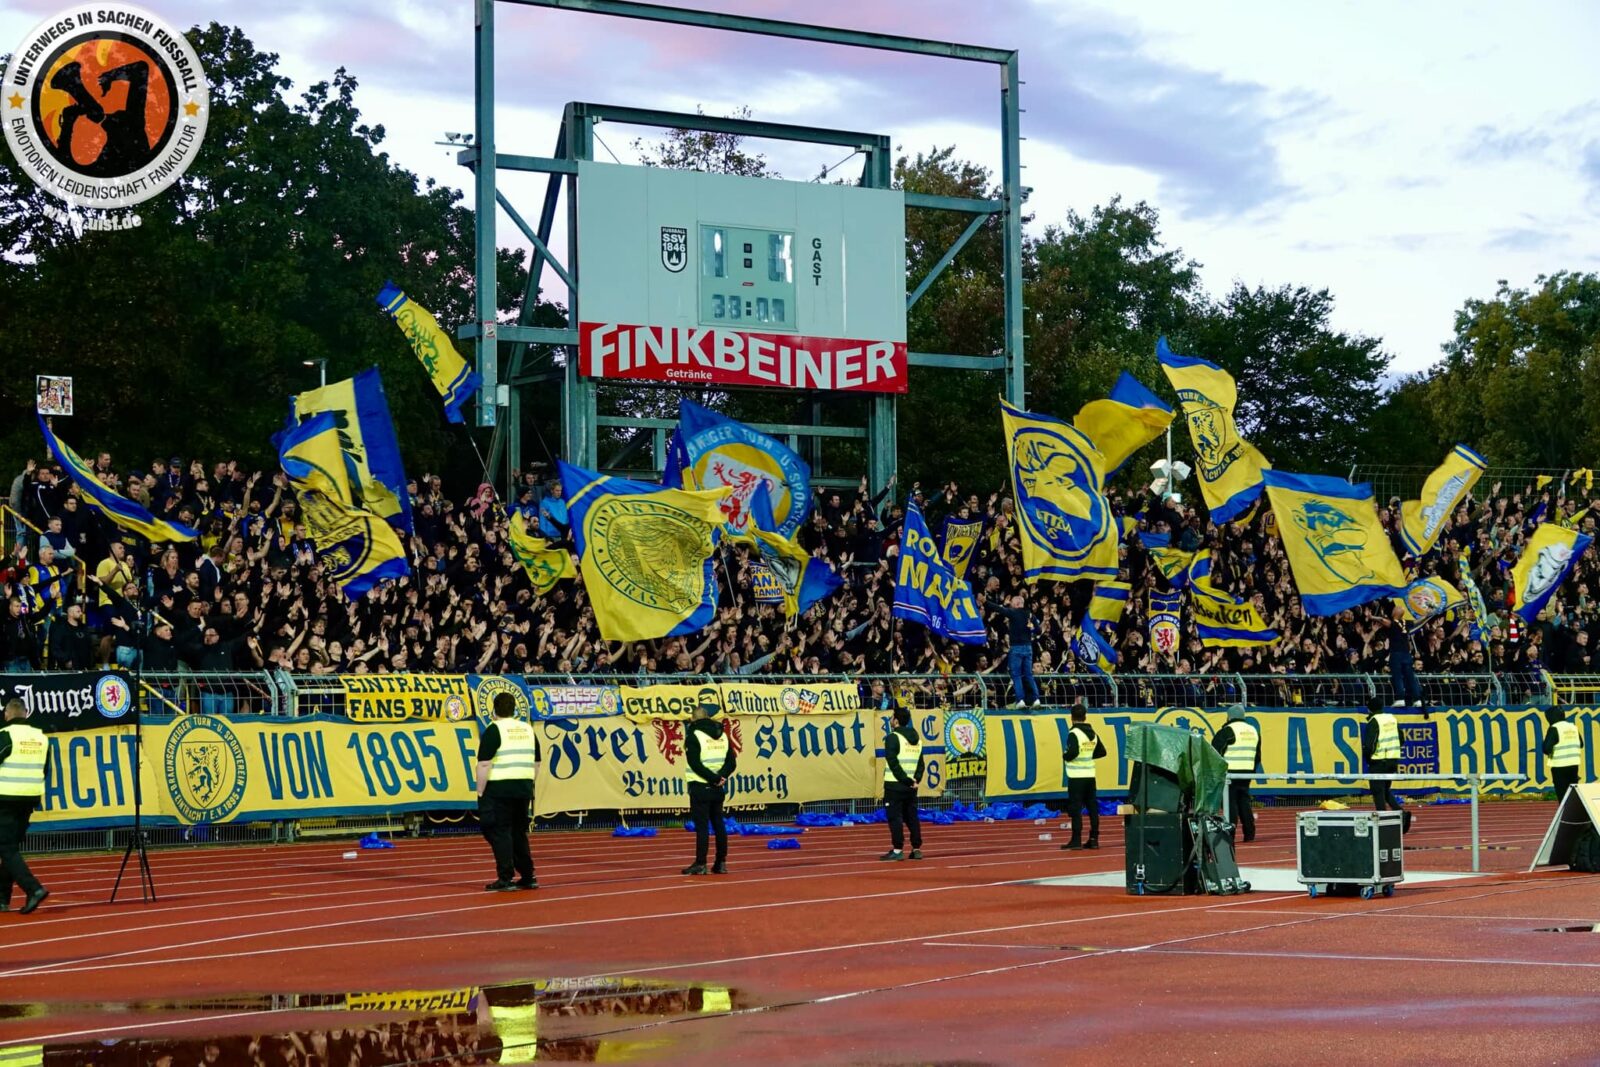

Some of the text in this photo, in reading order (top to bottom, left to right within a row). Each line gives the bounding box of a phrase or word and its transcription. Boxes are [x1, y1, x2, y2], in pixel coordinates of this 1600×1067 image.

[662, 233, 686, 243] SSV
[662, 243, 686, 252] 1846
[812, 238, 822, 286] GAST
[590, 323, 898, 390] FINKBEINER
[666, 368, 713, 380] Getränke
[343, 677, 465, 694] EINTRACHT
[14, 684, 95, 719] Jungs
[350, 698, 443, 719] FANS BW
[626, 696, 697, 715] CHAOS
[166, 720, 192, 792] BRAUNSCHWEIGER
[193, 717, 212, 726] TURN
[224, 730, 246, 786] SPORTVEREIN
[260, 730, 335, 800] VON
[347, 728, 449, 797] 1895
[946, 760, 987, 779] HARZ
[175, 794, 207, 821] EINTRACHT
